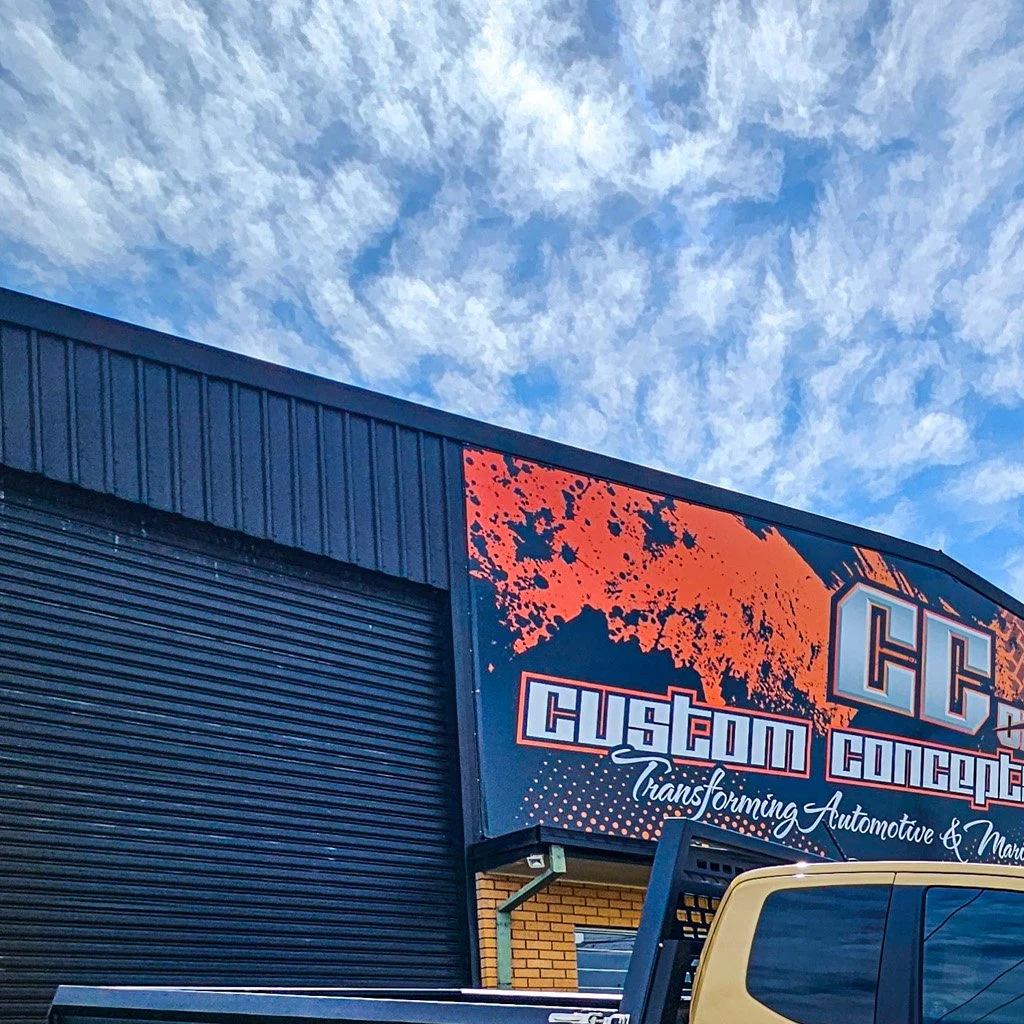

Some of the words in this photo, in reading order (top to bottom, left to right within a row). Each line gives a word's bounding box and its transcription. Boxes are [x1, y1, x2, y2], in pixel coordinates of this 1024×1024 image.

[833, 582, 992, 736] CC
[525, 681, 808, 772] custom
[611, 748, 800, 839] Transforming
[802, 790, 934, 844] Automotive
[939, 817, 968, 863] &
